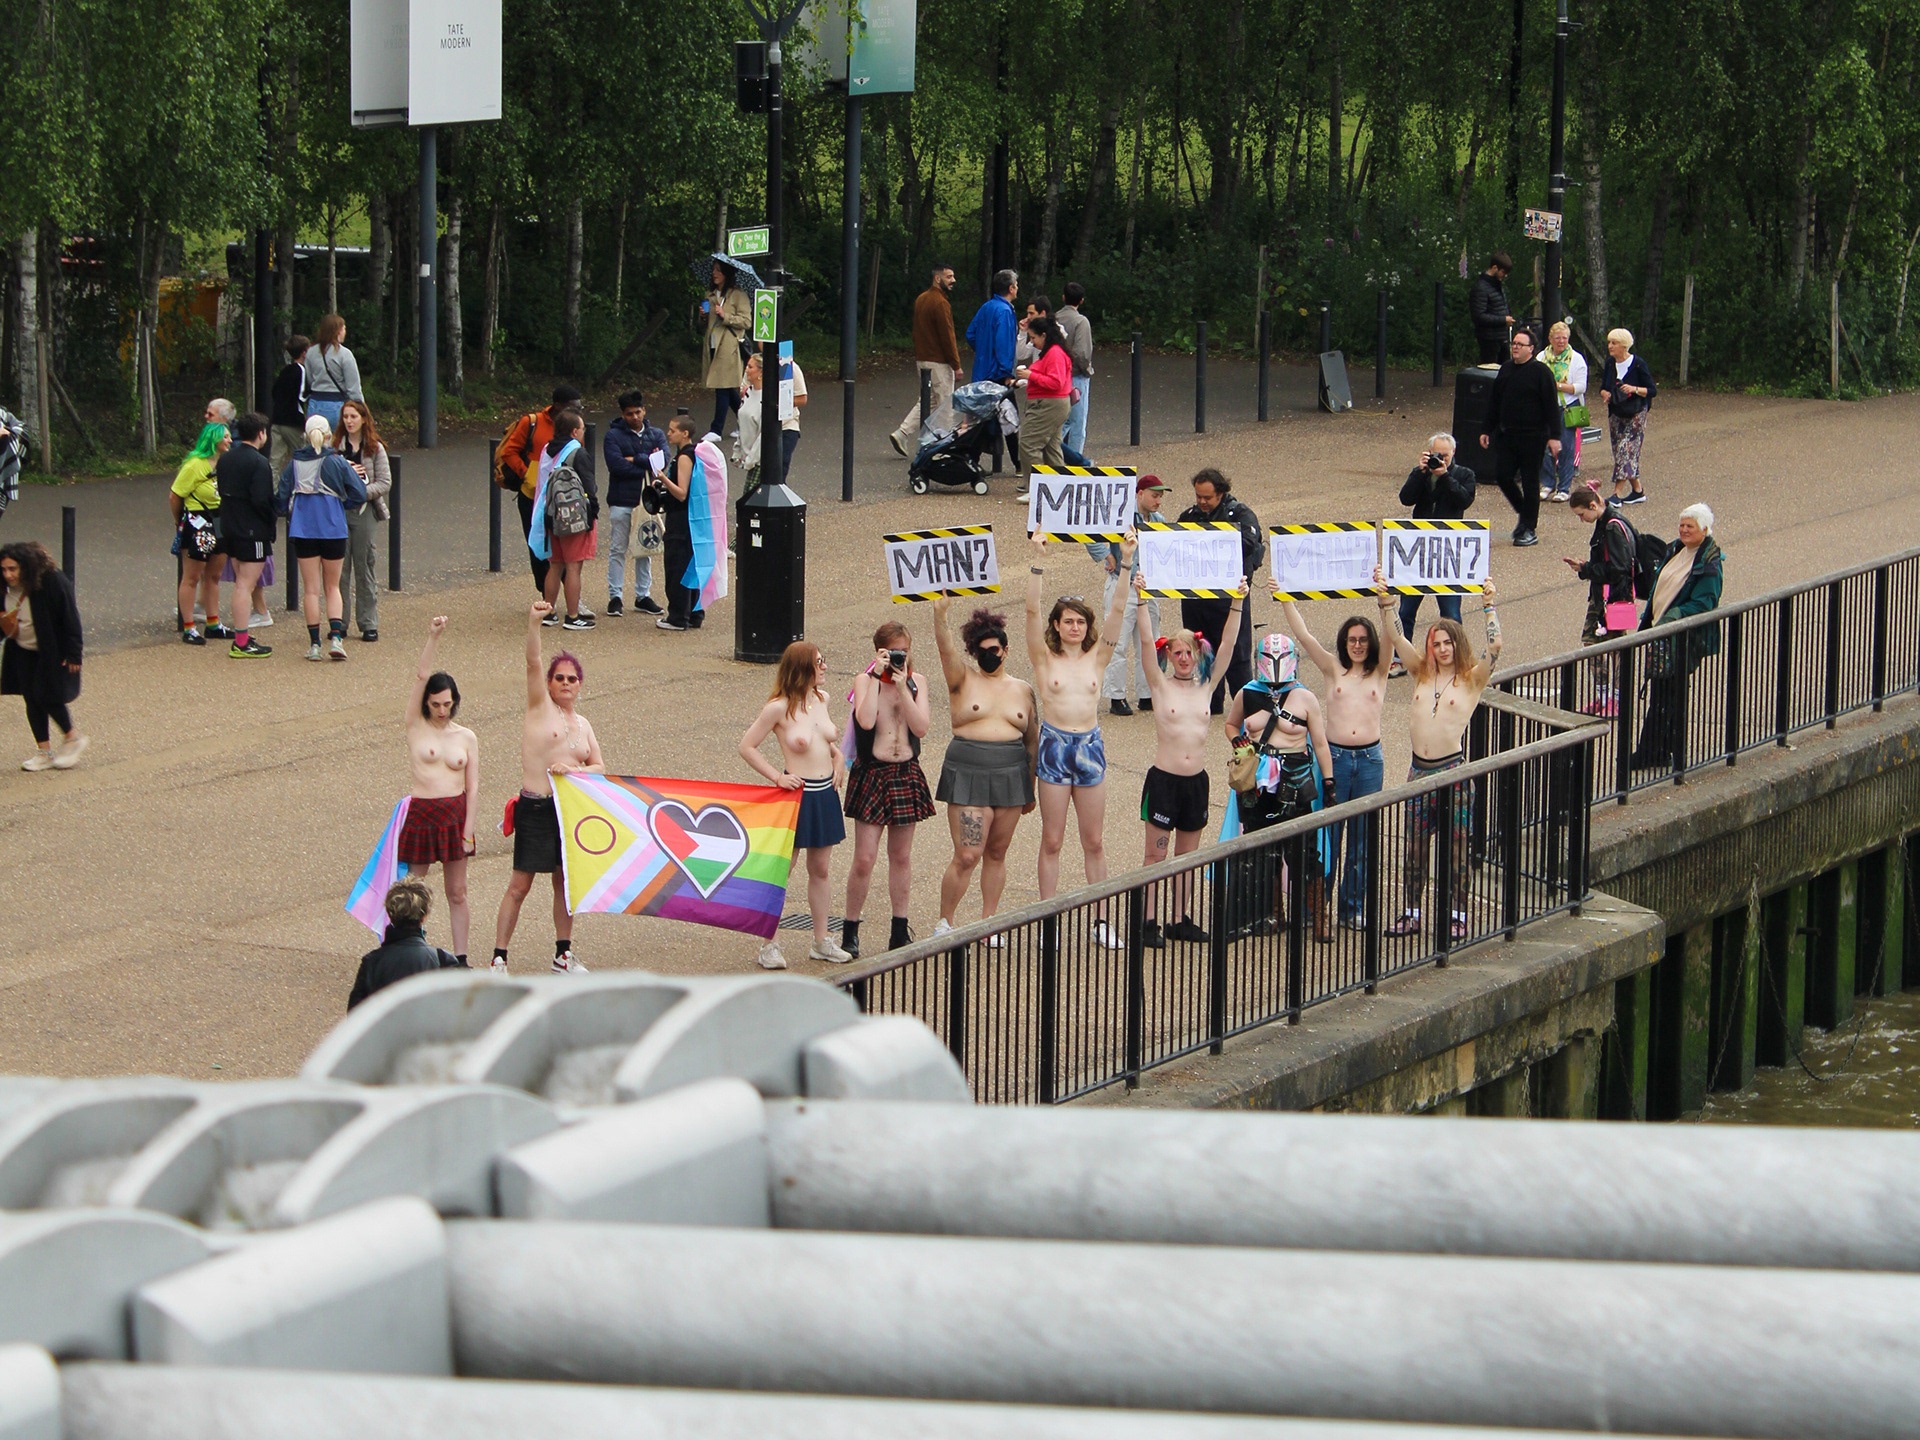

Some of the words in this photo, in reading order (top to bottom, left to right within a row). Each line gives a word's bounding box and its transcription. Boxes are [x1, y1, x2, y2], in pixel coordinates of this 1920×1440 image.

[440, 37, 471, 49] MODERN
[447, 24, 464, 35] TATE
[743, 233, 753, 242] Over
[745, 242, 759, 250] Bridge
[1035, 482, 1129, 527] MAN?
[892, 538, 990, 589] MAN?
[1145, 539, 1237, 578] MAN?
[1276, 536, 1371, 583] MAN?
[1388, 535, 1482, 580] MAN?
